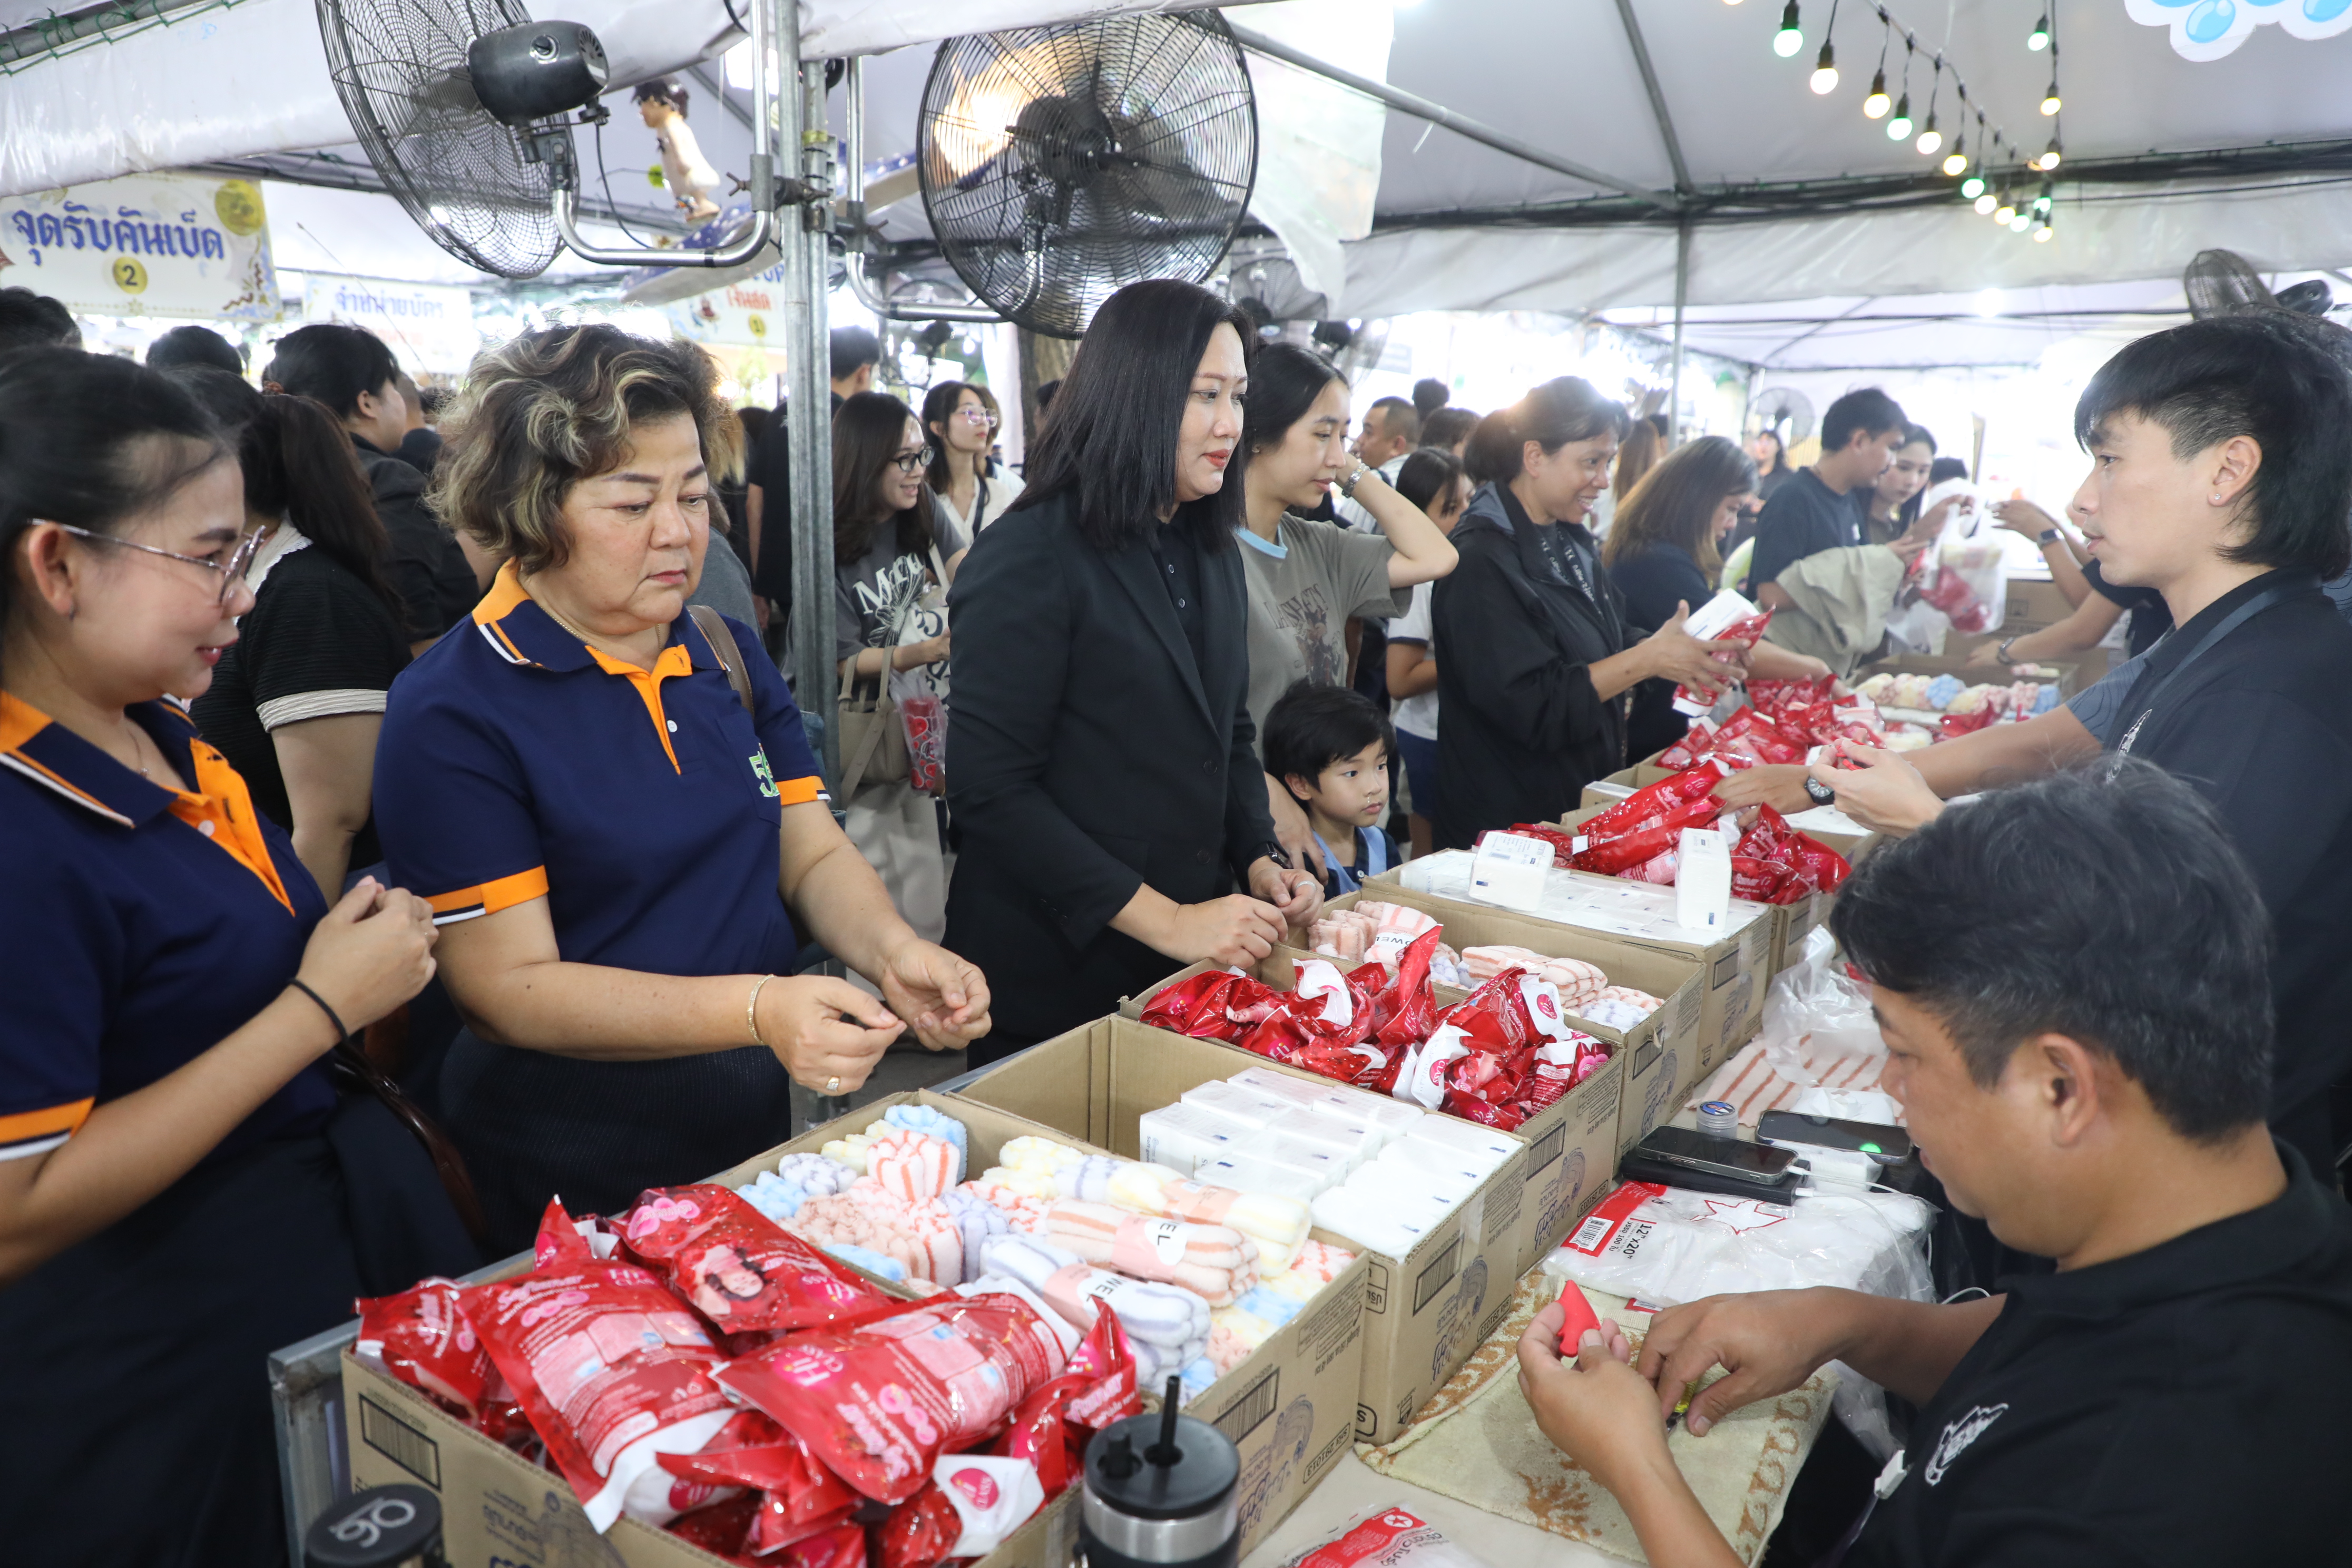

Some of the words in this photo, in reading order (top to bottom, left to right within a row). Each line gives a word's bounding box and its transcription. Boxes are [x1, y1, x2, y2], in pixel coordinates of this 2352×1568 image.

[12, 201, 224, 266] จุดรับคันเบ็ด
[122, 266, 138, 286] 2
[1614, 1234, 1624, 1244] 100
[1619, 1221, 1633, 1233] บรรจุ
[792, 1356, 831, 1387] Hi
[1307, 1442, 1335, 1477] 291013
